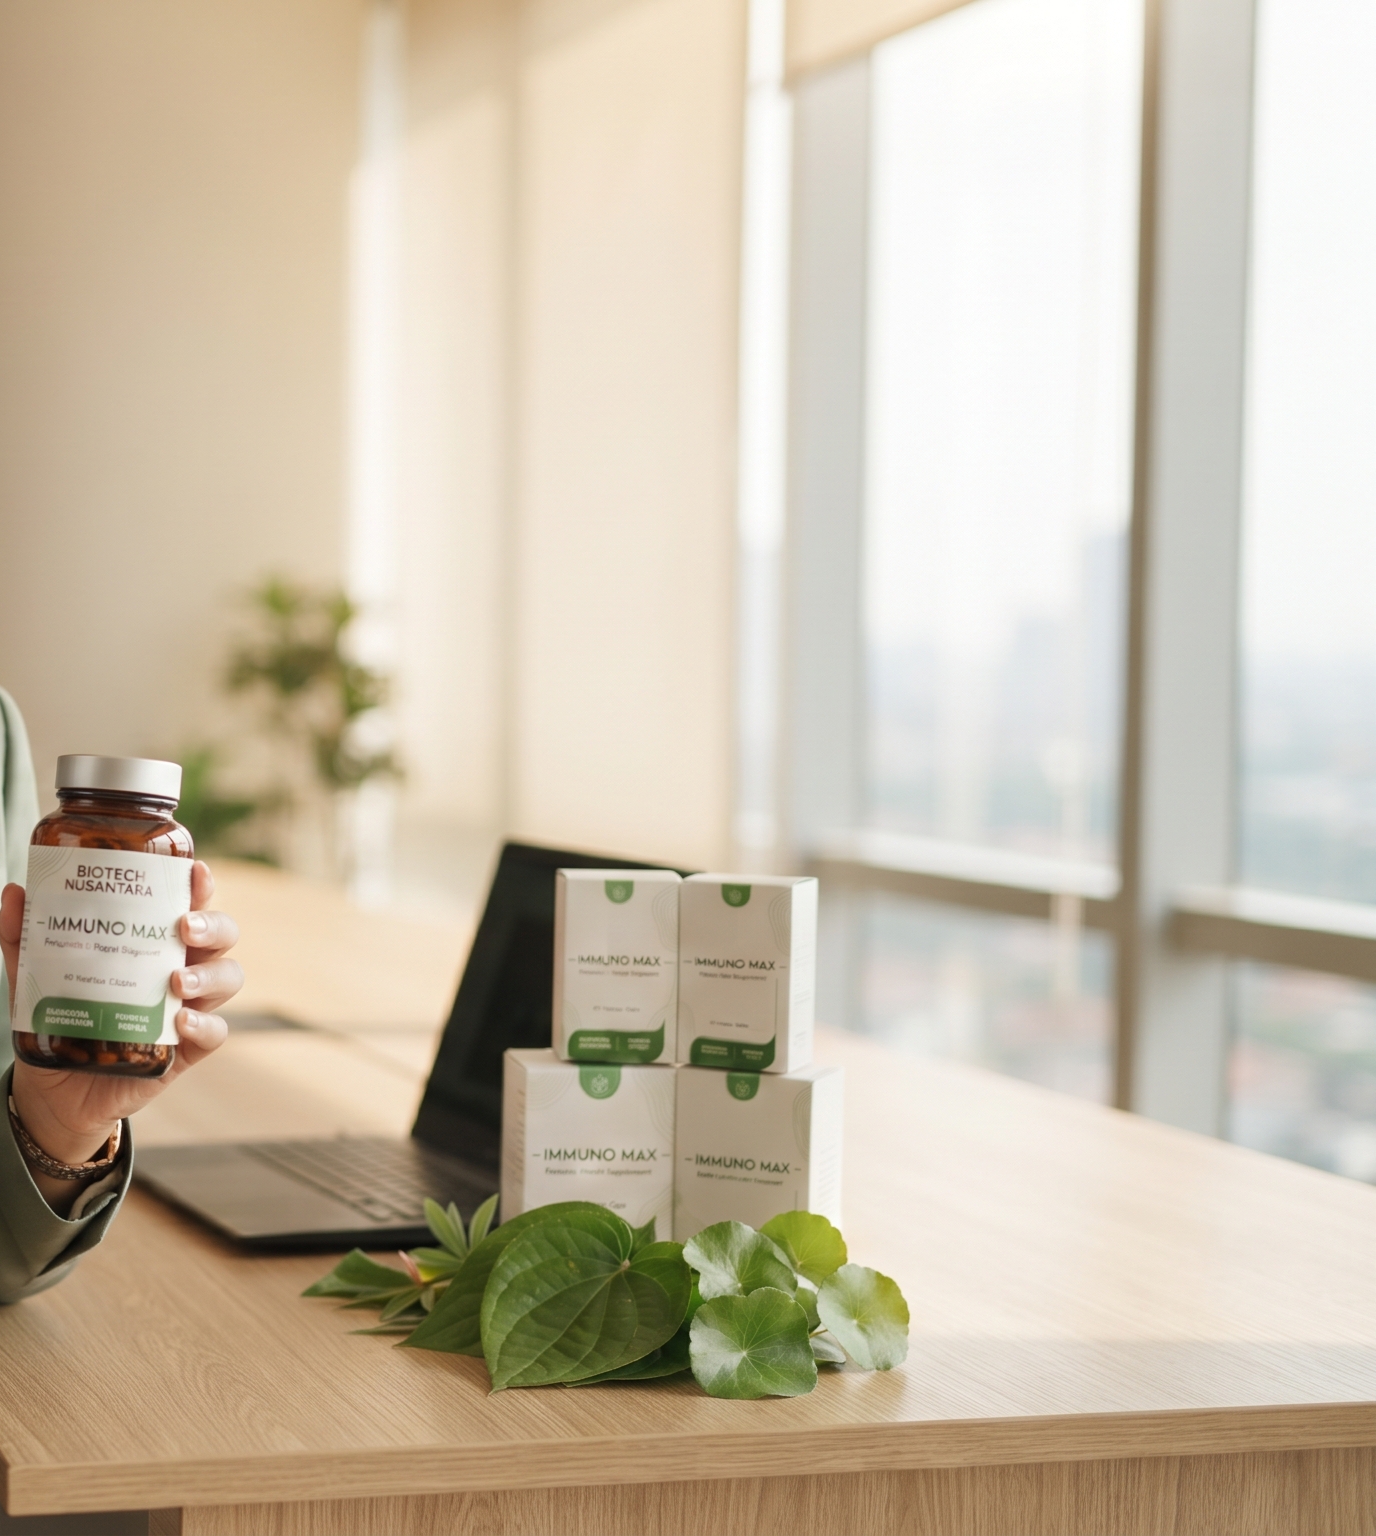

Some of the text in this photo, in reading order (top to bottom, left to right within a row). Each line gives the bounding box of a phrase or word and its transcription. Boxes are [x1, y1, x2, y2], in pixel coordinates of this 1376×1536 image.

[77, 865, 145, 882] BIOTECH
[64, 879, 153, 897] NUSANTARA
[48, 916, 167, 941] IMMUNO MAX
[577, 955, 661, 967] IMMUNO MAX
[694, 957, 776, 971] IMMUNO MAX
[544, 1148, 657, 1162] IMMUNO MAX
[695, 1153, 791, 1174] IMMUNO MAX
